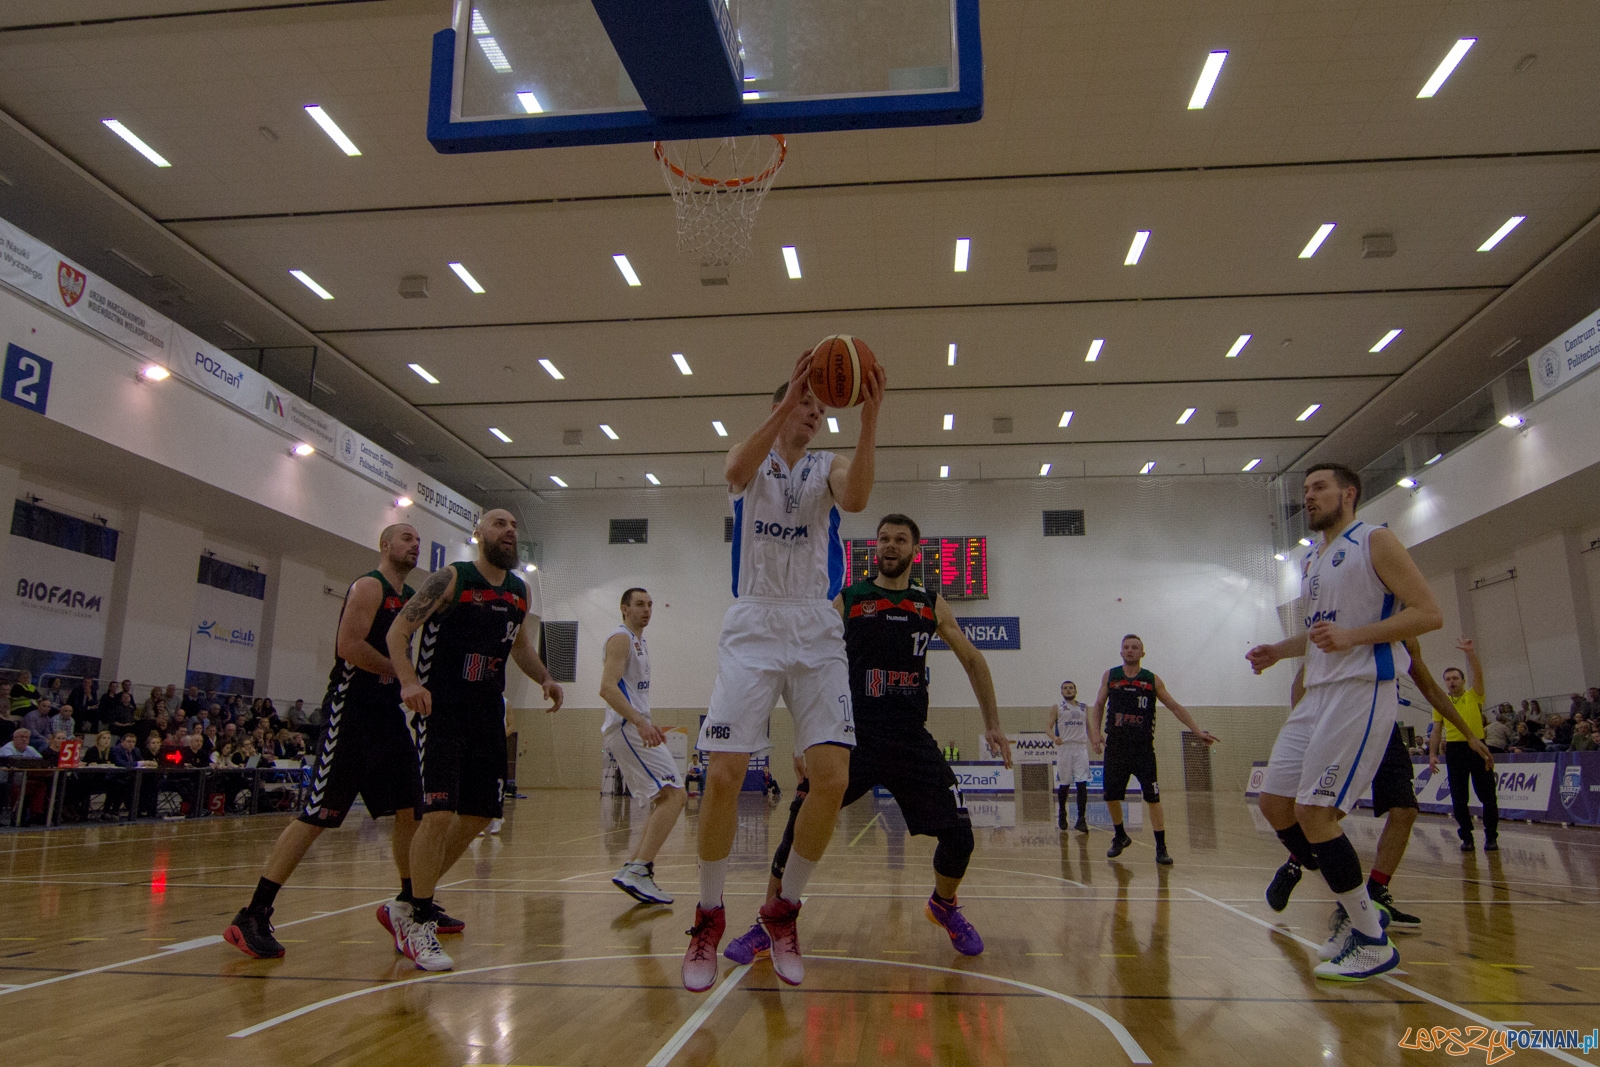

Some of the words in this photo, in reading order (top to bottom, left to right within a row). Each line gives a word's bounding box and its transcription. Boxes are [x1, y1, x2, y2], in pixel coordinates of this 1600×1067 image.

[6, 240, 30, 260] Nauki
[1564, 326, 1596, 352] Centrum
[14, 356, 41, 405] 2
[834, 353, 846, 399] molten
[360, 442, 380, 461] Centrum
[417, 481, 480, 528] cspp.put.poznan.pl
[435, 547, 442, 571] 1
[16, 578, 102, 612] BIOFARM
[886, 613, 909, 622] hummel
[911, 631, 930, 657] 12
[887, 670, 920, 687] PEC
[1136, 696, 1149, 709] 10
[711, 725, 731, 740] PBG
[60, 743, 74, 761] 5
[1016, 739, 1055, 750] MAXXX
[1319, 764, 1340, 790] 6
[209, 795, 222, 811] 5
